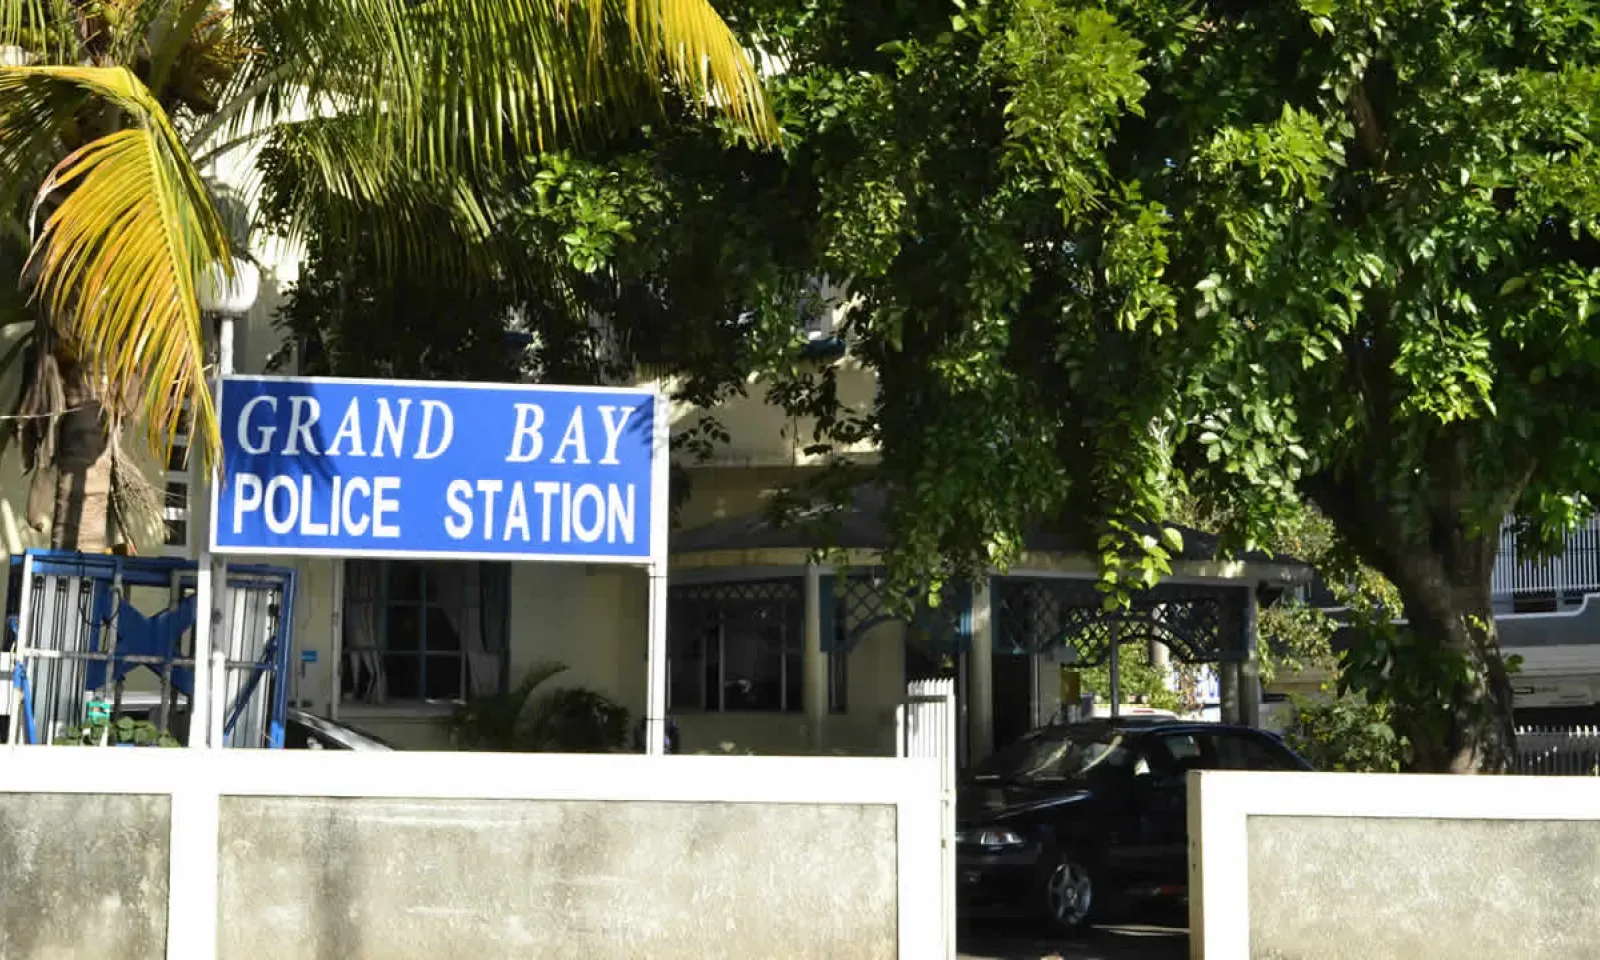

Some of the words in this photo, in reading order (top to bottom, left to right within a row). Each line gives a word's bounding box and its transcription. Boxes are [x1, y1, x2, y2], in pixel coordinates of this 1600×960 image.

[237, 395, 454, 460] GRAND
[505, 403, 636, 465] BAY
[232, 473, 401, 537] POLICE
[444, 478, 635, 544] STATION
